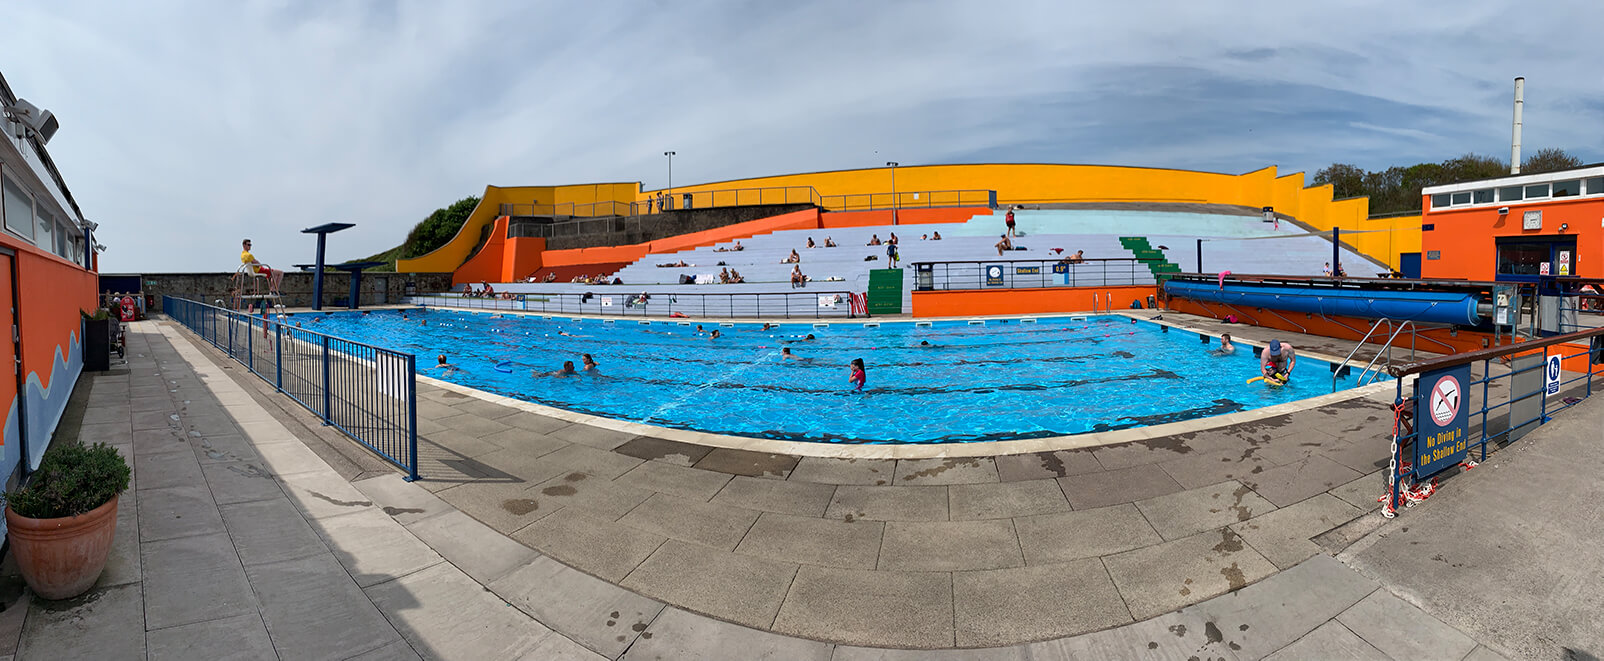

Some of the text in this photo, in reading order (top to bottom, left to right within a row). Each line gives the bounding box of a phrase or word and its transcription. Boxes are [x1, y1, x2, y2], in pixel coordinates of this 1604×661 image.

[1427, 427, 1462, 448] No Diving in
[1420, 439, 1466, 466] the Shallow End
